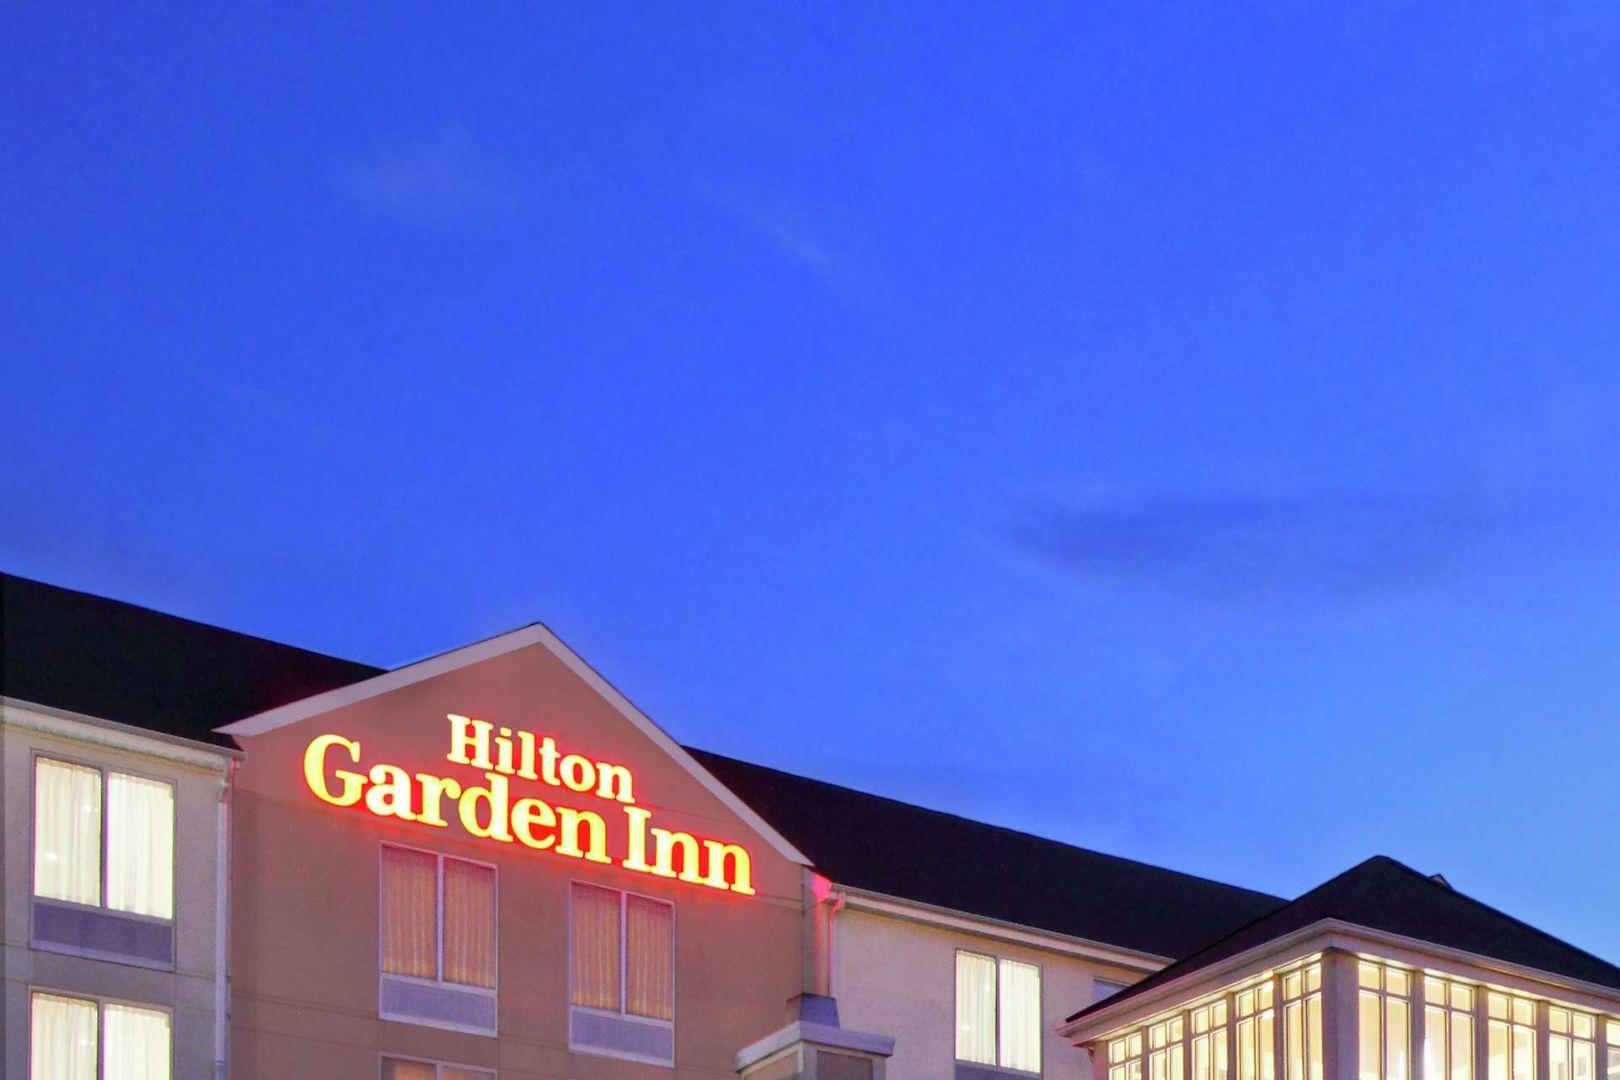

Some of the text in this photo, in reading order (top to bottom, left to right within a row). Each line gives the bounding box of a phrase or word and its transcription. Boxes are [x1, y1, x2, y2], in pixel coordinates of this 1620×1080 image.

[303, 733, 756, 896] Garden Inn
[446, 713, 636, 804] Hilton
